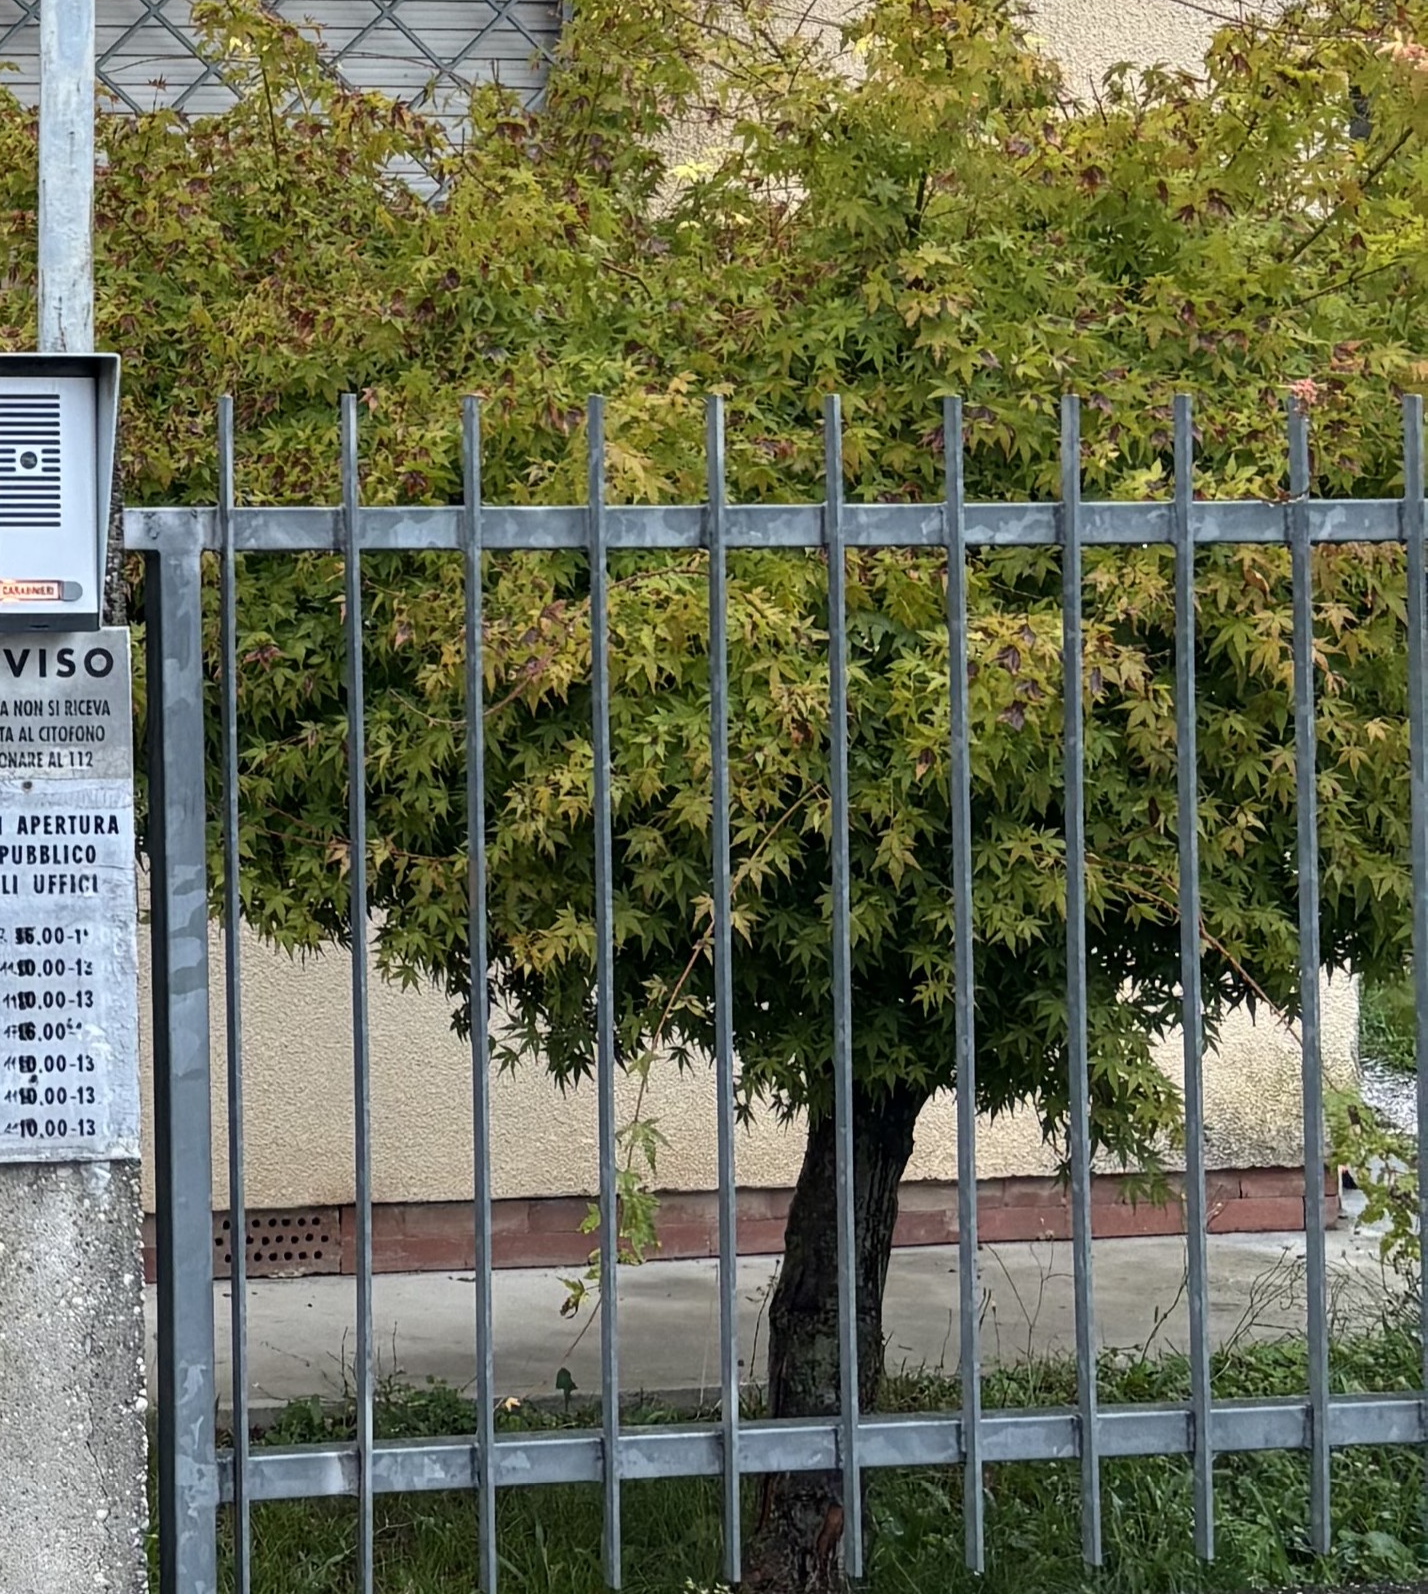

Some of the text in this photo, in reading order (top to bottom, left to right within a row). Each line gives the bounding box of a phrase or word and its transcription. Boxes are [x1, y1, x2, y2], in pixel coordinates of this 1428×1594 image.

[14, 700, 43, 717] NON
[48, 700, 60, 717] SI
[65, 699, 111, 716] RICEVA
[19, 726, 34, 742] AL
[39, 725, 106, 742] CITOFONO
[48, 752, 64, 768] AL
[68, 751, 93, 768] 112
[16, 815, 119, 835] APERTURA
[33, 874, 99, 895] UFFICI
